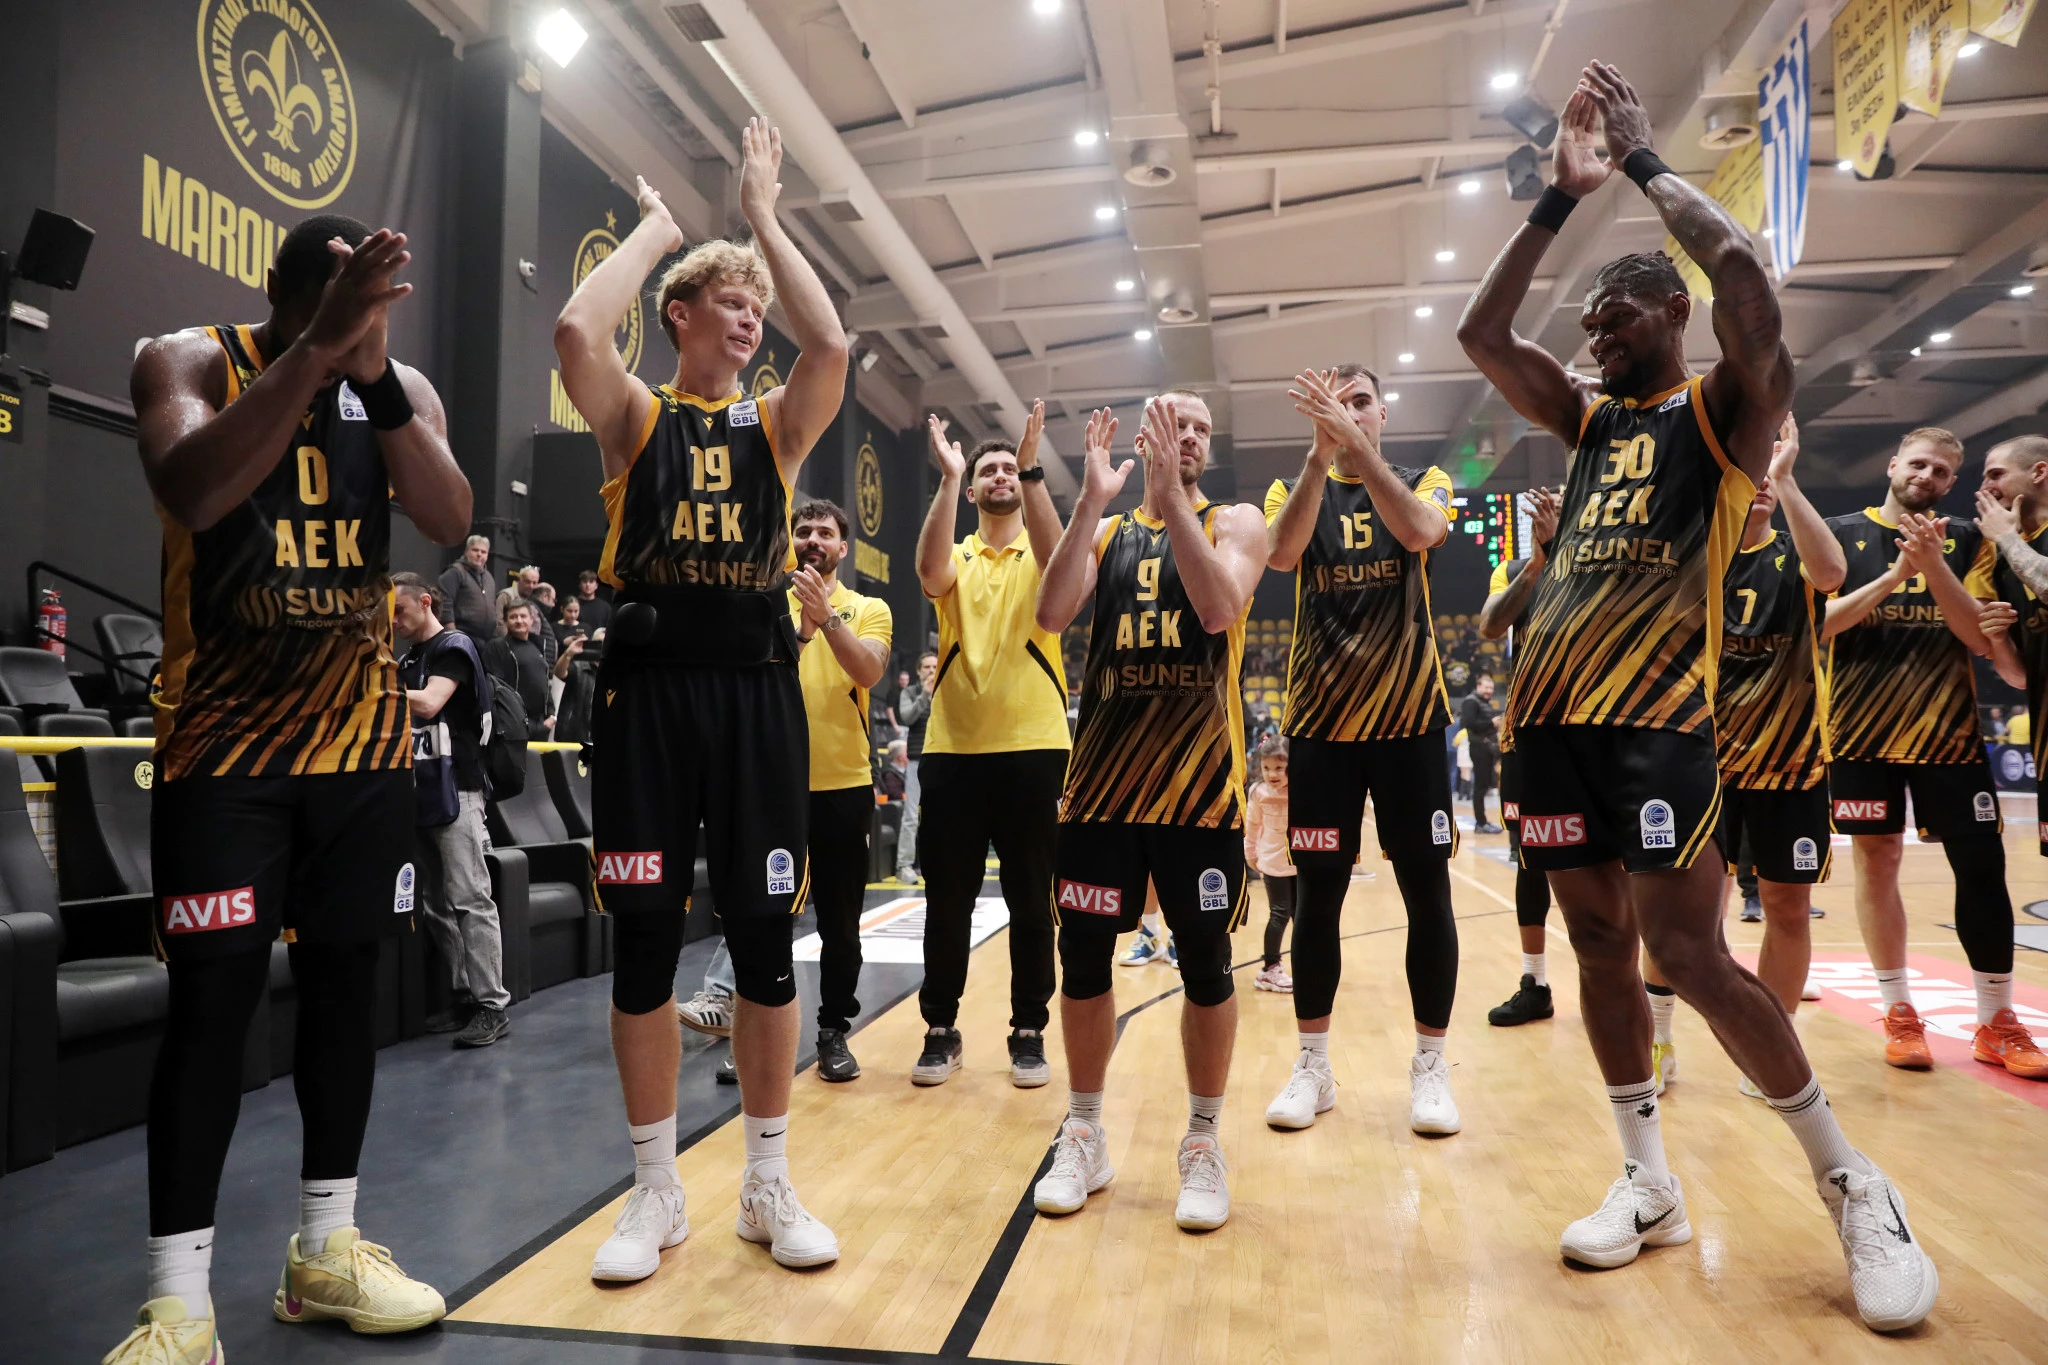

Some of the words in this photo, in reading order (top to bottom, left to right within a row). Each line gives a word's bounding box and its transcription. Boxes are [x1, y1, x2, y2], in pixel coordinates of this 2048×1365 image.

[262, 151, 302, 189] 1896
[143, 153, 289, 292] MAROU
[344, 408, 364, 418] GB
[1662, 396, 1685, 410] GBL
[732, 416, 756, 425] GBL
[690, 445, 732, 492] 19
[1601, 433, 1655, 483] 30
[297, 446, 328, 505] 0
[672, 500, 743, 542] AEK
[1578, 485, 1655, 530] AEK
[275, 519, 364, 568] AEK
[1340, 512, 1373, 549] 15
[1574, 537, 1680, 567] SUNEL
[1136, 557, 1161, 600] 9
[1573, 560, 1635, 574] Empowering
[1637, 564, 1680, 578] Change
[285, 587, 362, 616] SUN
[1736, 588, 1758, 625] 7
[1884, 605, 1945, 621] SUNE
[1116, 609, 1182, 651] AEK
[1121, 663, 1214, 687] SUNEL
[1178, 688, 1214, 699] Change
[1835, 802, 1885, 819] AVIS
[1292, 830, 1338, 849] AVIS
[1434, 835, 1450, 843] GBL
[1522, 817, 1584, 843] AVIS
[1645, 835, 1672, 846] GBL
[598, 854, 662, 881] AVIS
[1796, 861, 1816, 869] GBL
[769, 881, 793, 892] GBL
[1059, 884, 1120, 914] AVIS
[166, 891, 254, 930] AVIS
[1202, 898, 1227, 908] GBL
